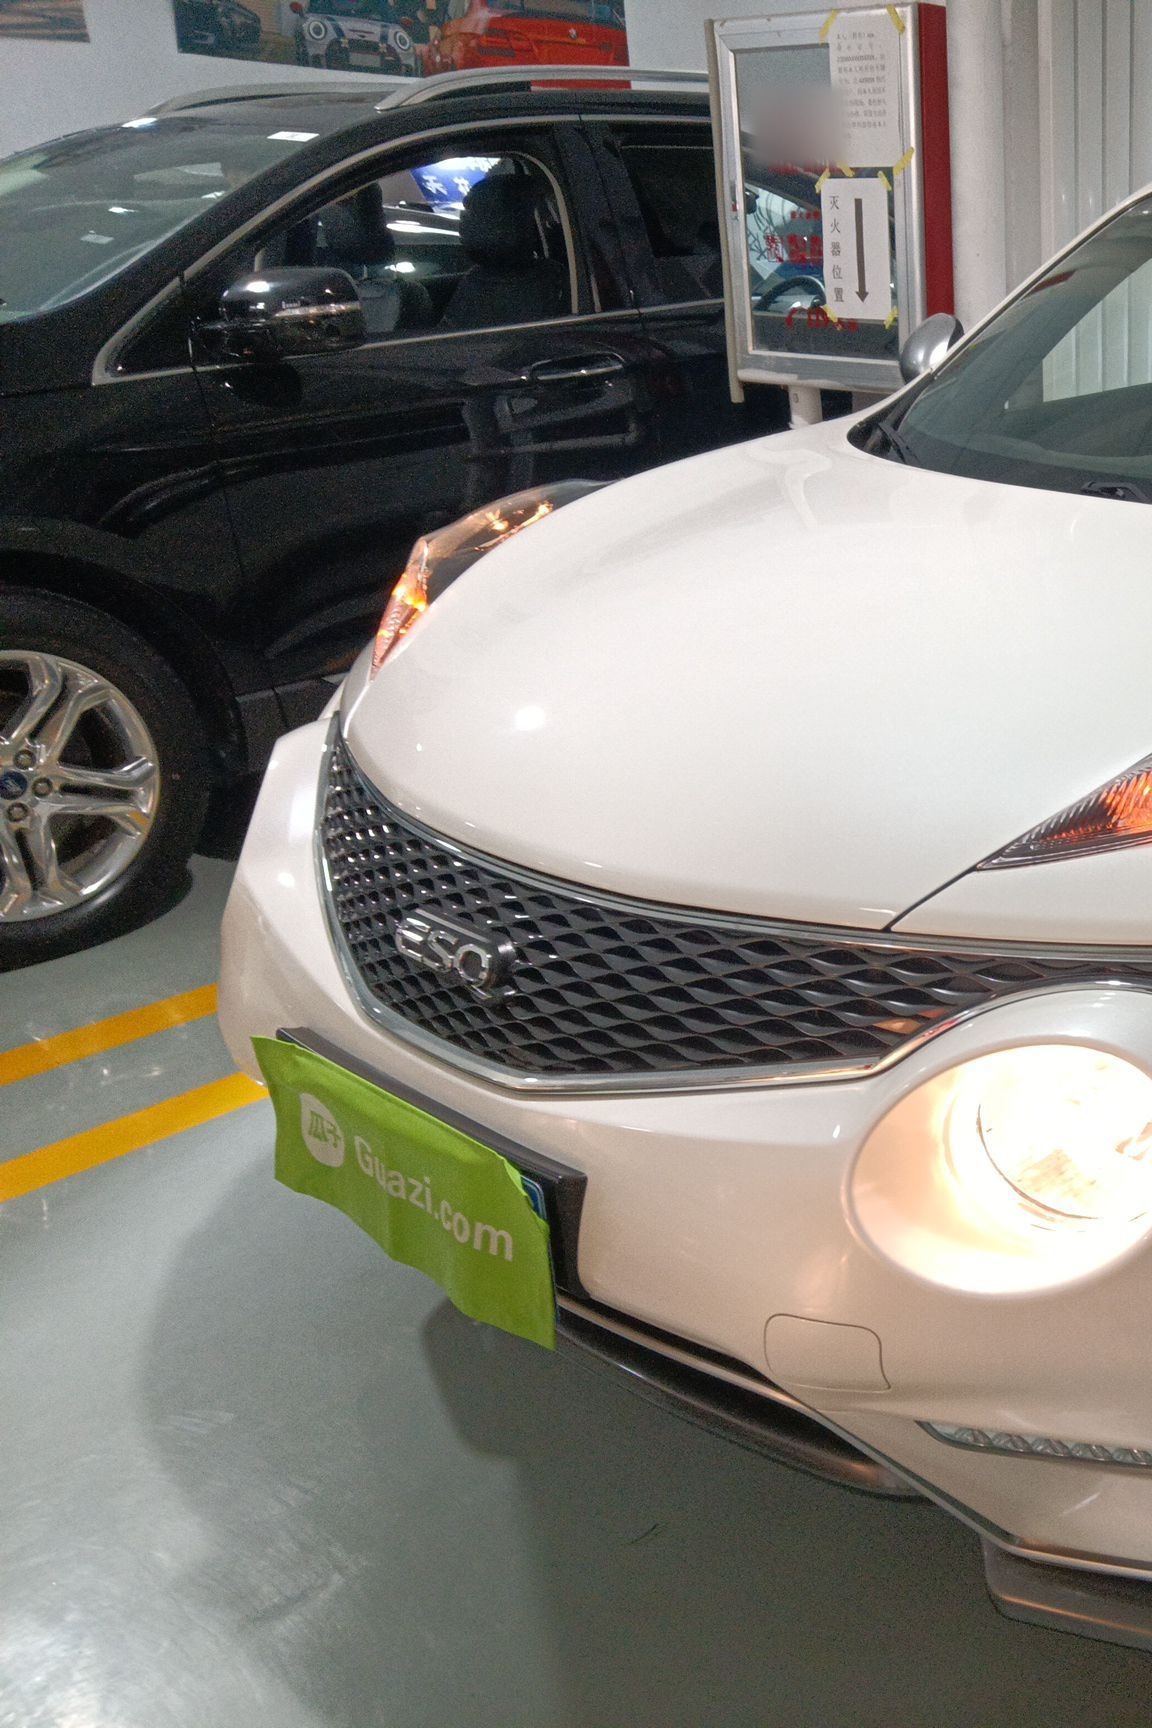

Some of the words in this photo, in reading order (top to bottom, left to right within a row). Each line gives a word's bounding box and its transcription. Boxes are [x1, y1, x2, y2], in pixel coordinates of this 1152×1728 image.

[828, 195, 845, 303] 灭火器位置
[396, 917, 493, 1000] ESQ
[353, 1135, 513, 1262] Guazi.com
